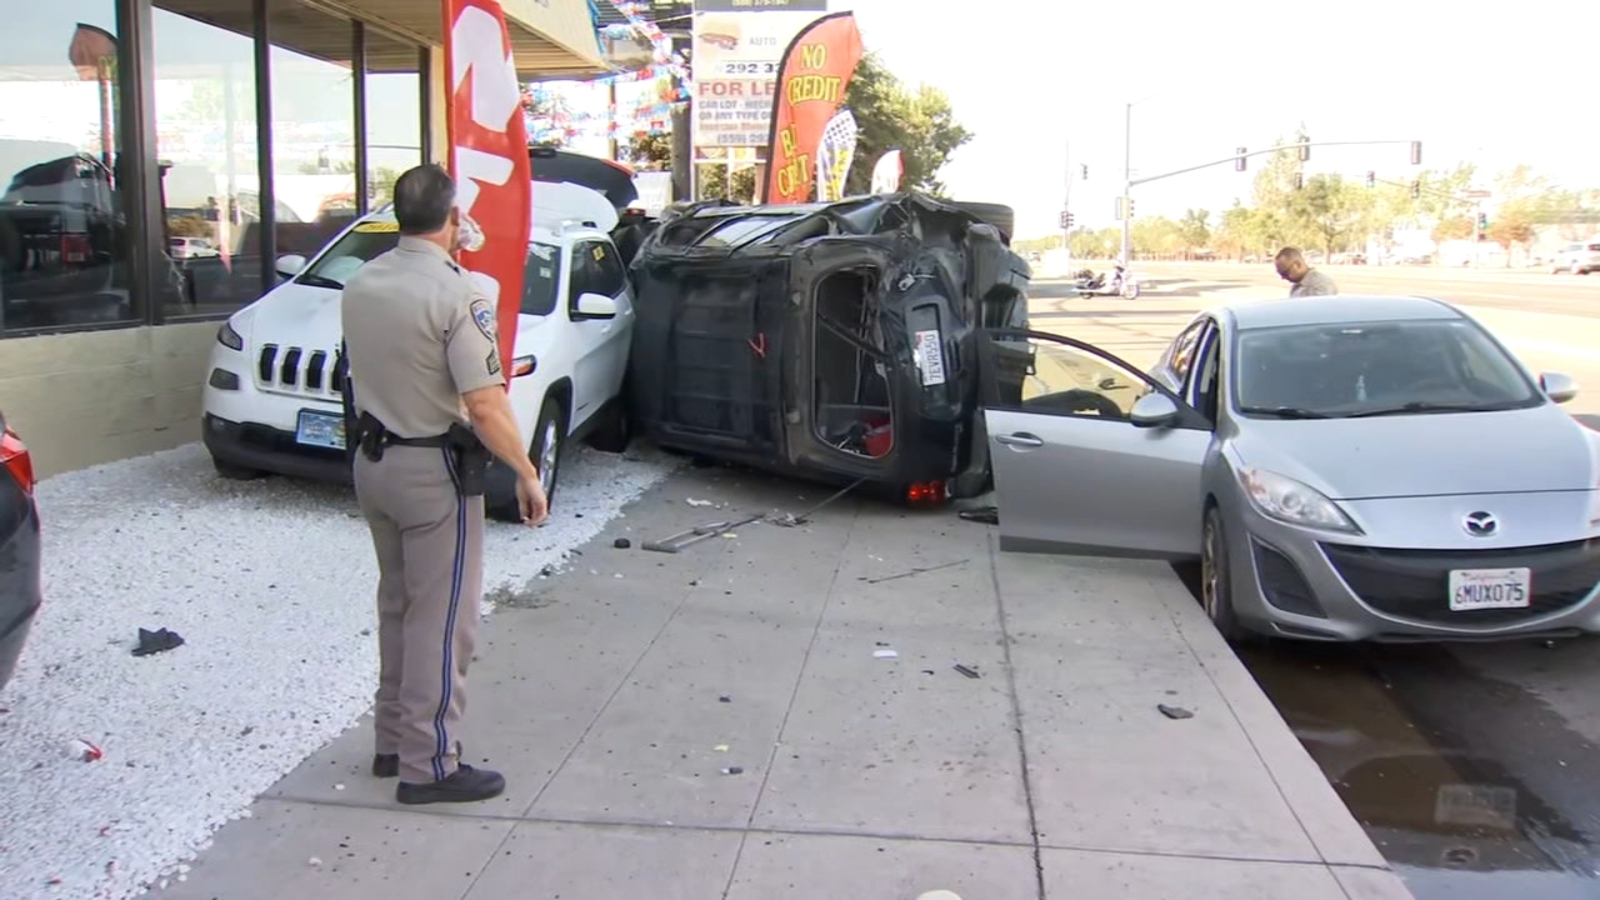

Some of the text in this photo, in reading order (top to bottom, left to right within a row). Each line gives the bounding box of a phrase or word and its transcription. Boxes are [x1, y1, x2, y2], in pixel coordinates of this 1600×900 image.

[749, 36, 777, 46] AUTO
[801, 44, 827, 70] NO
[725, 63, 758, 74] 292
[698, 81, 743, 96] FOR
[787, 75, 841, 105] CREDIT
[720, 99, 738, 110] LOT
[735, 111, 759, 121] TYPE
[1454, 582, 1524, 604] 6MUX075
